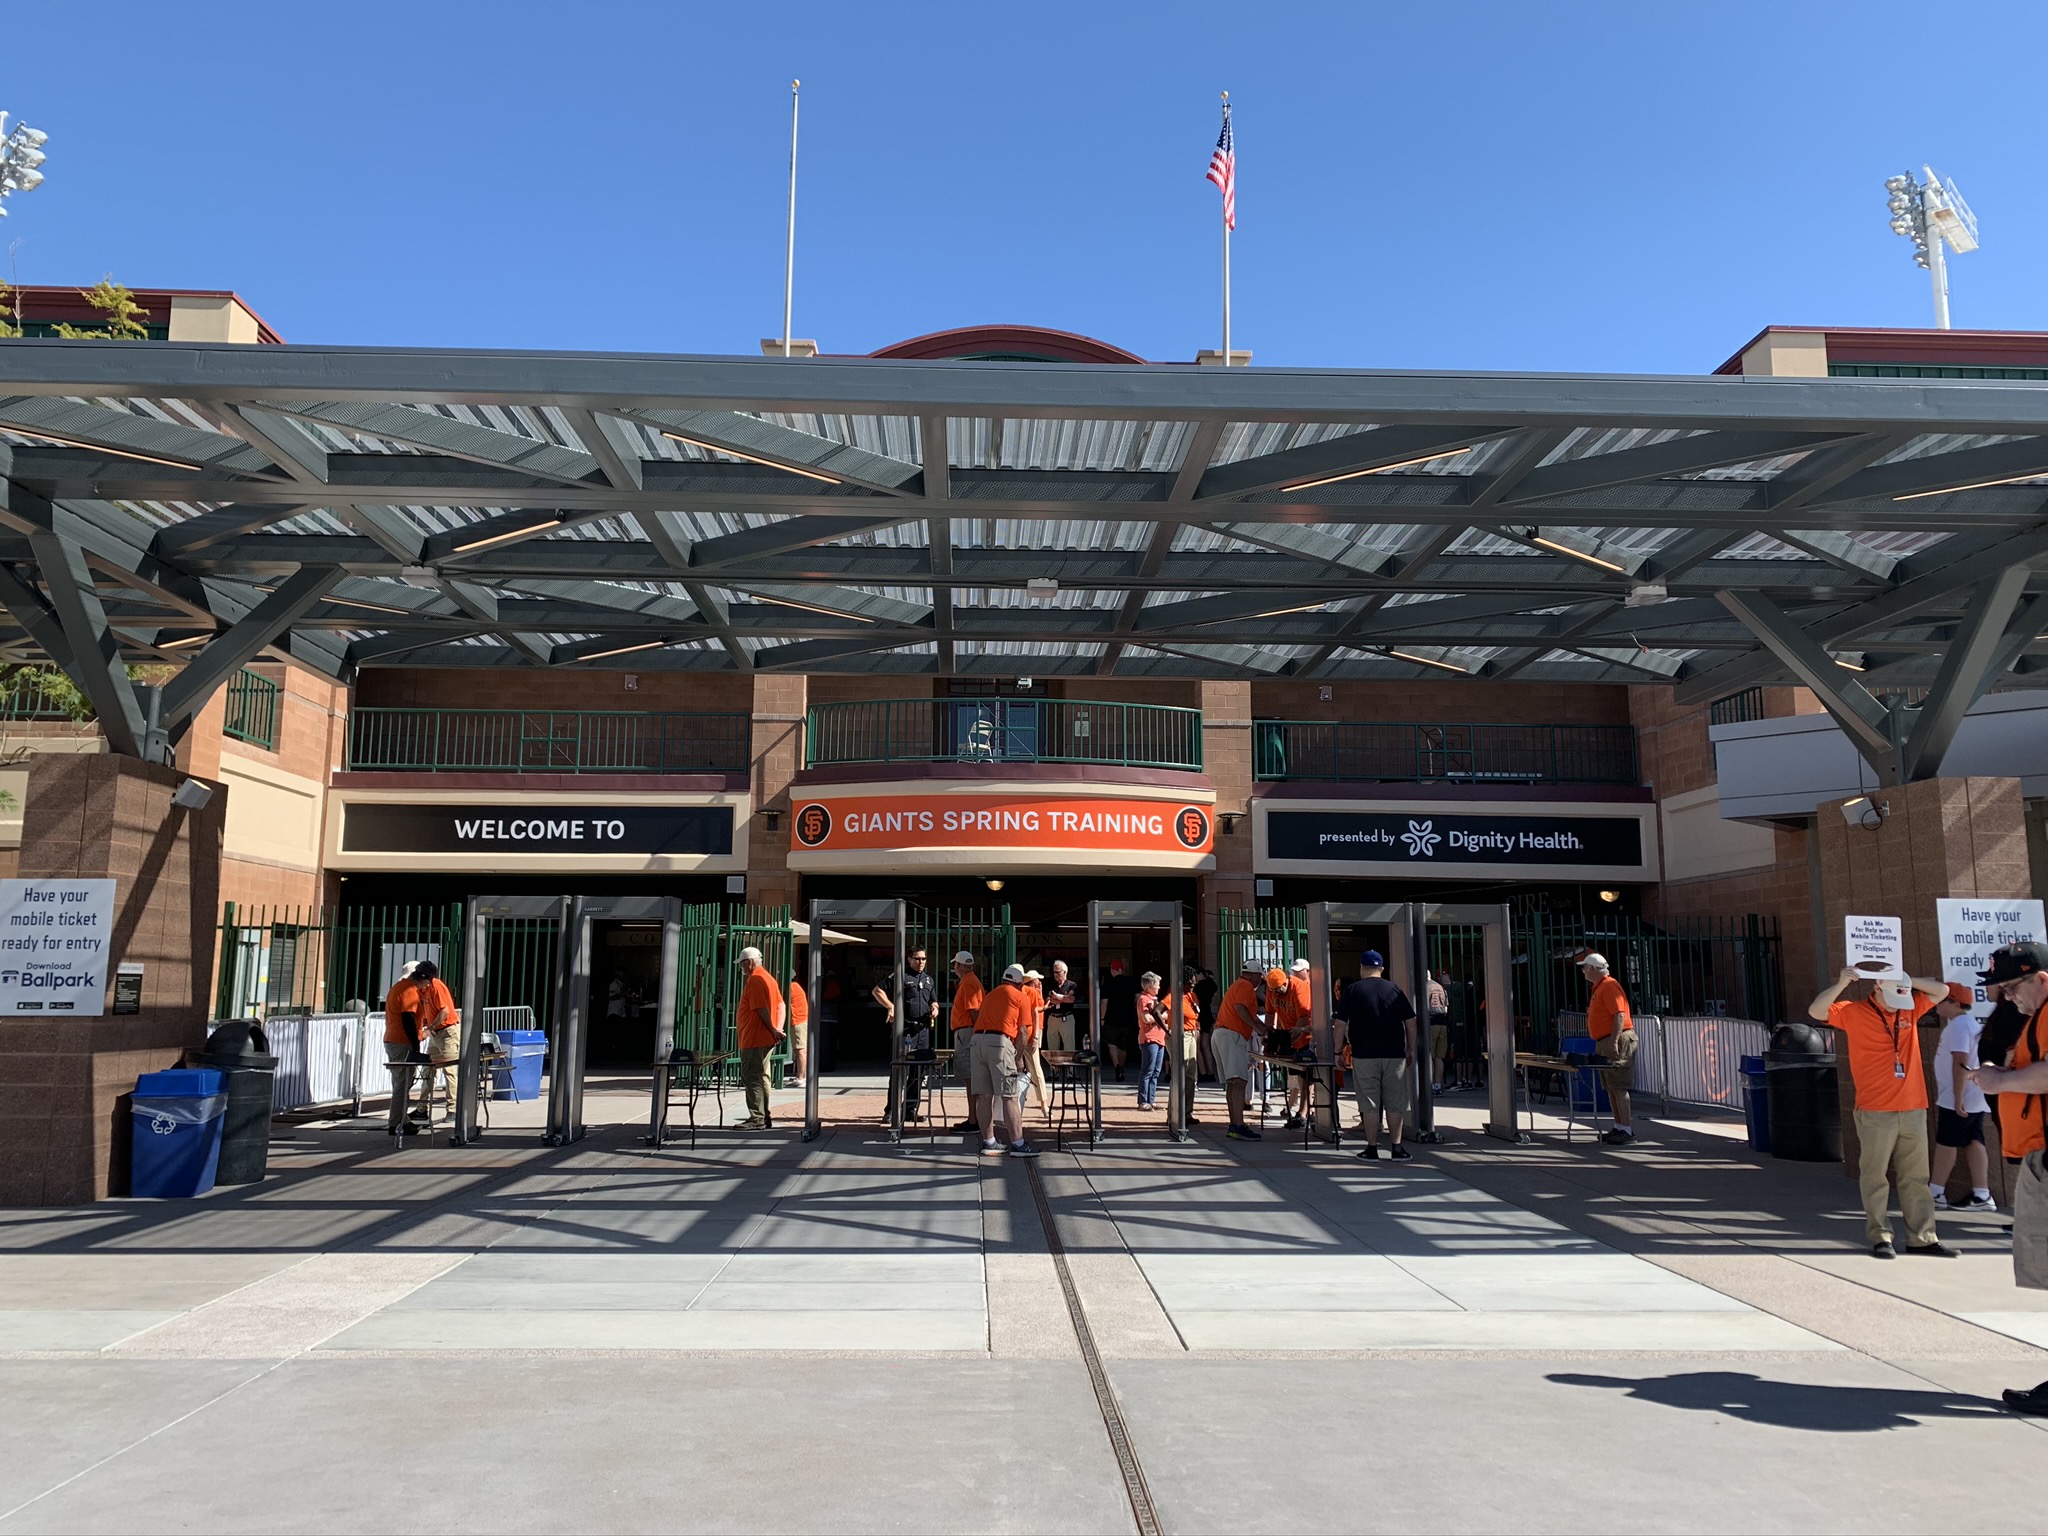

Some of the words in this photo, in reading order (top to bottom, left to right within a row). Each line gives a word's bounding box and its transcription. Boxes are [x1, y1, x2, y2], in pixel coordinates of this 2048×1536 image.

[454, 819, 584, 840] WELCOME
[592, 820, 625, 840] TO
[844, 811, 934, 833] GIANTS
[943, 810, 1039, 831] SPRING
[1047, 811, 1163, 835] TRAINING
[1319, 828, 1378, 845] presented
[1381, 828, 1396, 846] by
[1449, 830, 1516, 853] Dignity
[24, 887, 56, 902] Have
[60, 891, 89, 905] your
[10, 911, 54, 926] mobile
[58, 911, 97, 926] ticket
[1961, 907, 1991, 922] Have
[1994, 911, 2022, 924] your
[1864, 927, 1878, 935] Help
[1870, 933, 1897, 942] Ticketing
[1954, 930, 1995, 945] mobile
[1, 935, 39, 953] ready
[42, 934, 63, 950] for
[66, 936, 102, 953] entry
[1862, 945, 1894, 953] Ballpark
[26, 962, 72, 970] Download
[1950, 952, 1985, 970] ready
[21, 972, 95, 991] Ballpark
